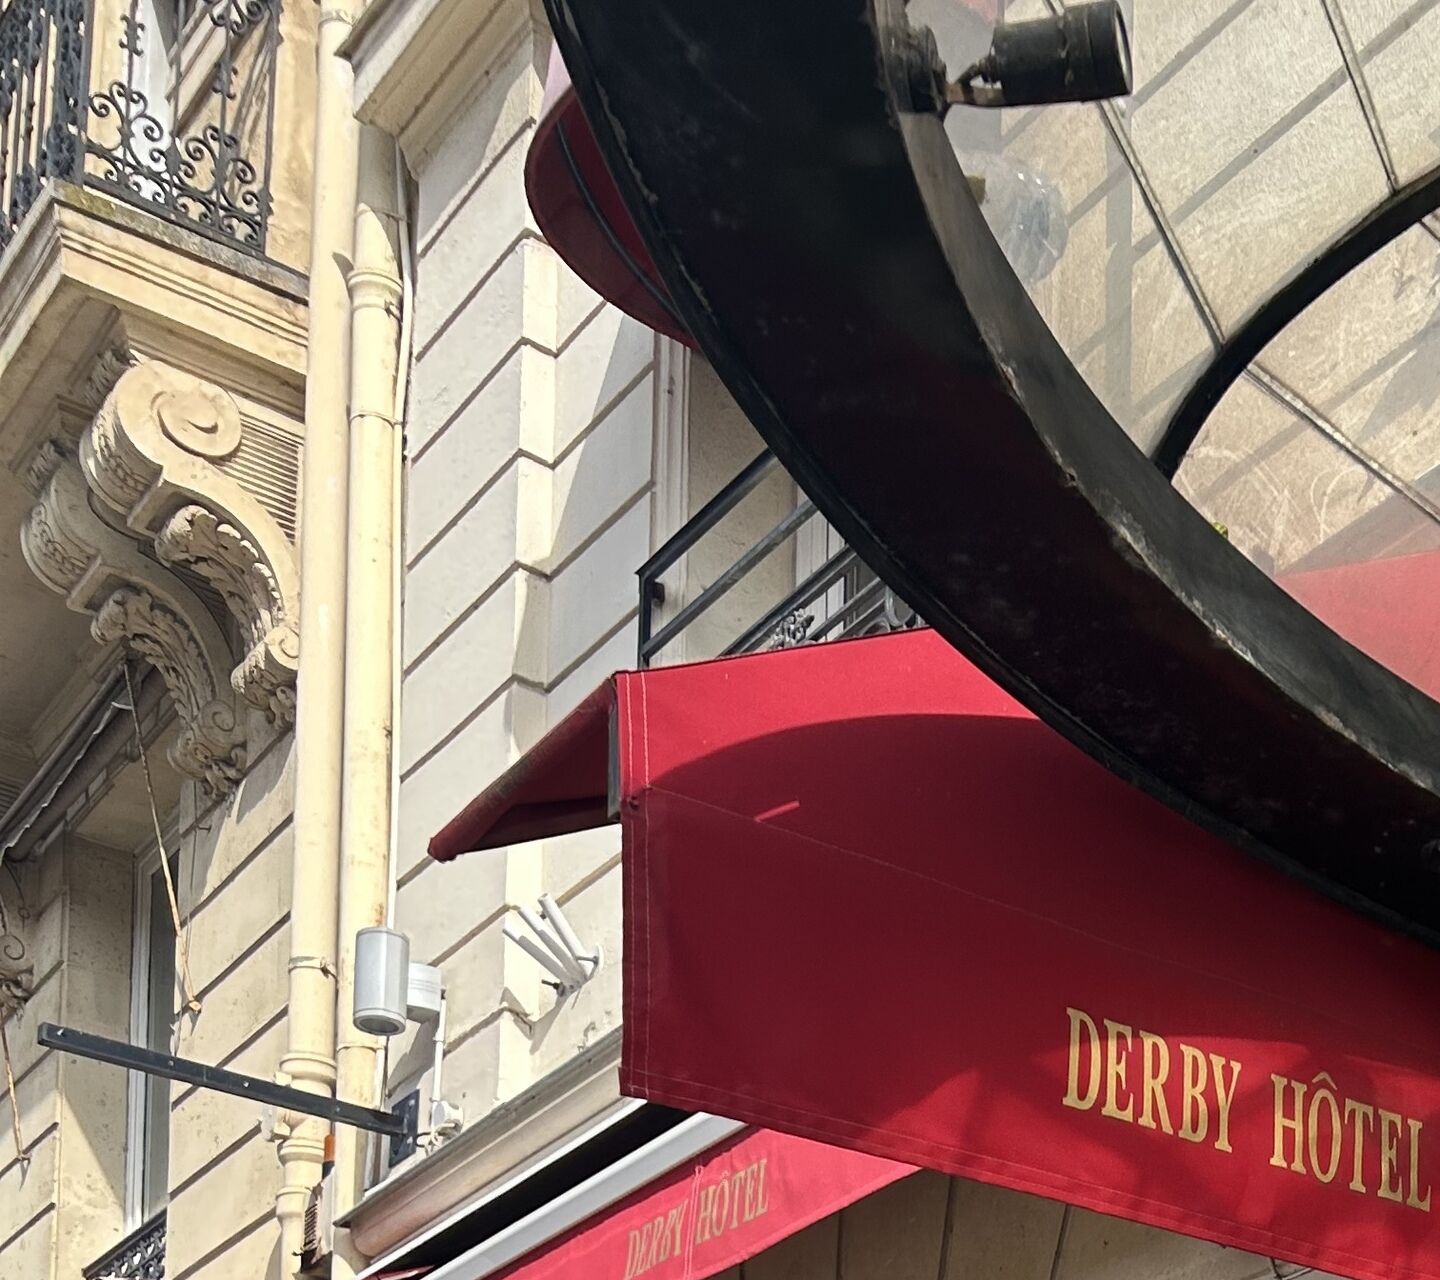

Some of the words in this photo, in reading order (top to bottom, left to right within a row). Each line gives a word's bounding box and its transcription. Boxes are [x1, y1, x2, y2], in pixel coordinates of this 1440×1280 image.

[1062, 1007, 1241, 1153] DERBY
[1269, 1071, 1431, 1212] HÔTEL
[695, 1158, 768, 1245] HÔTEL
